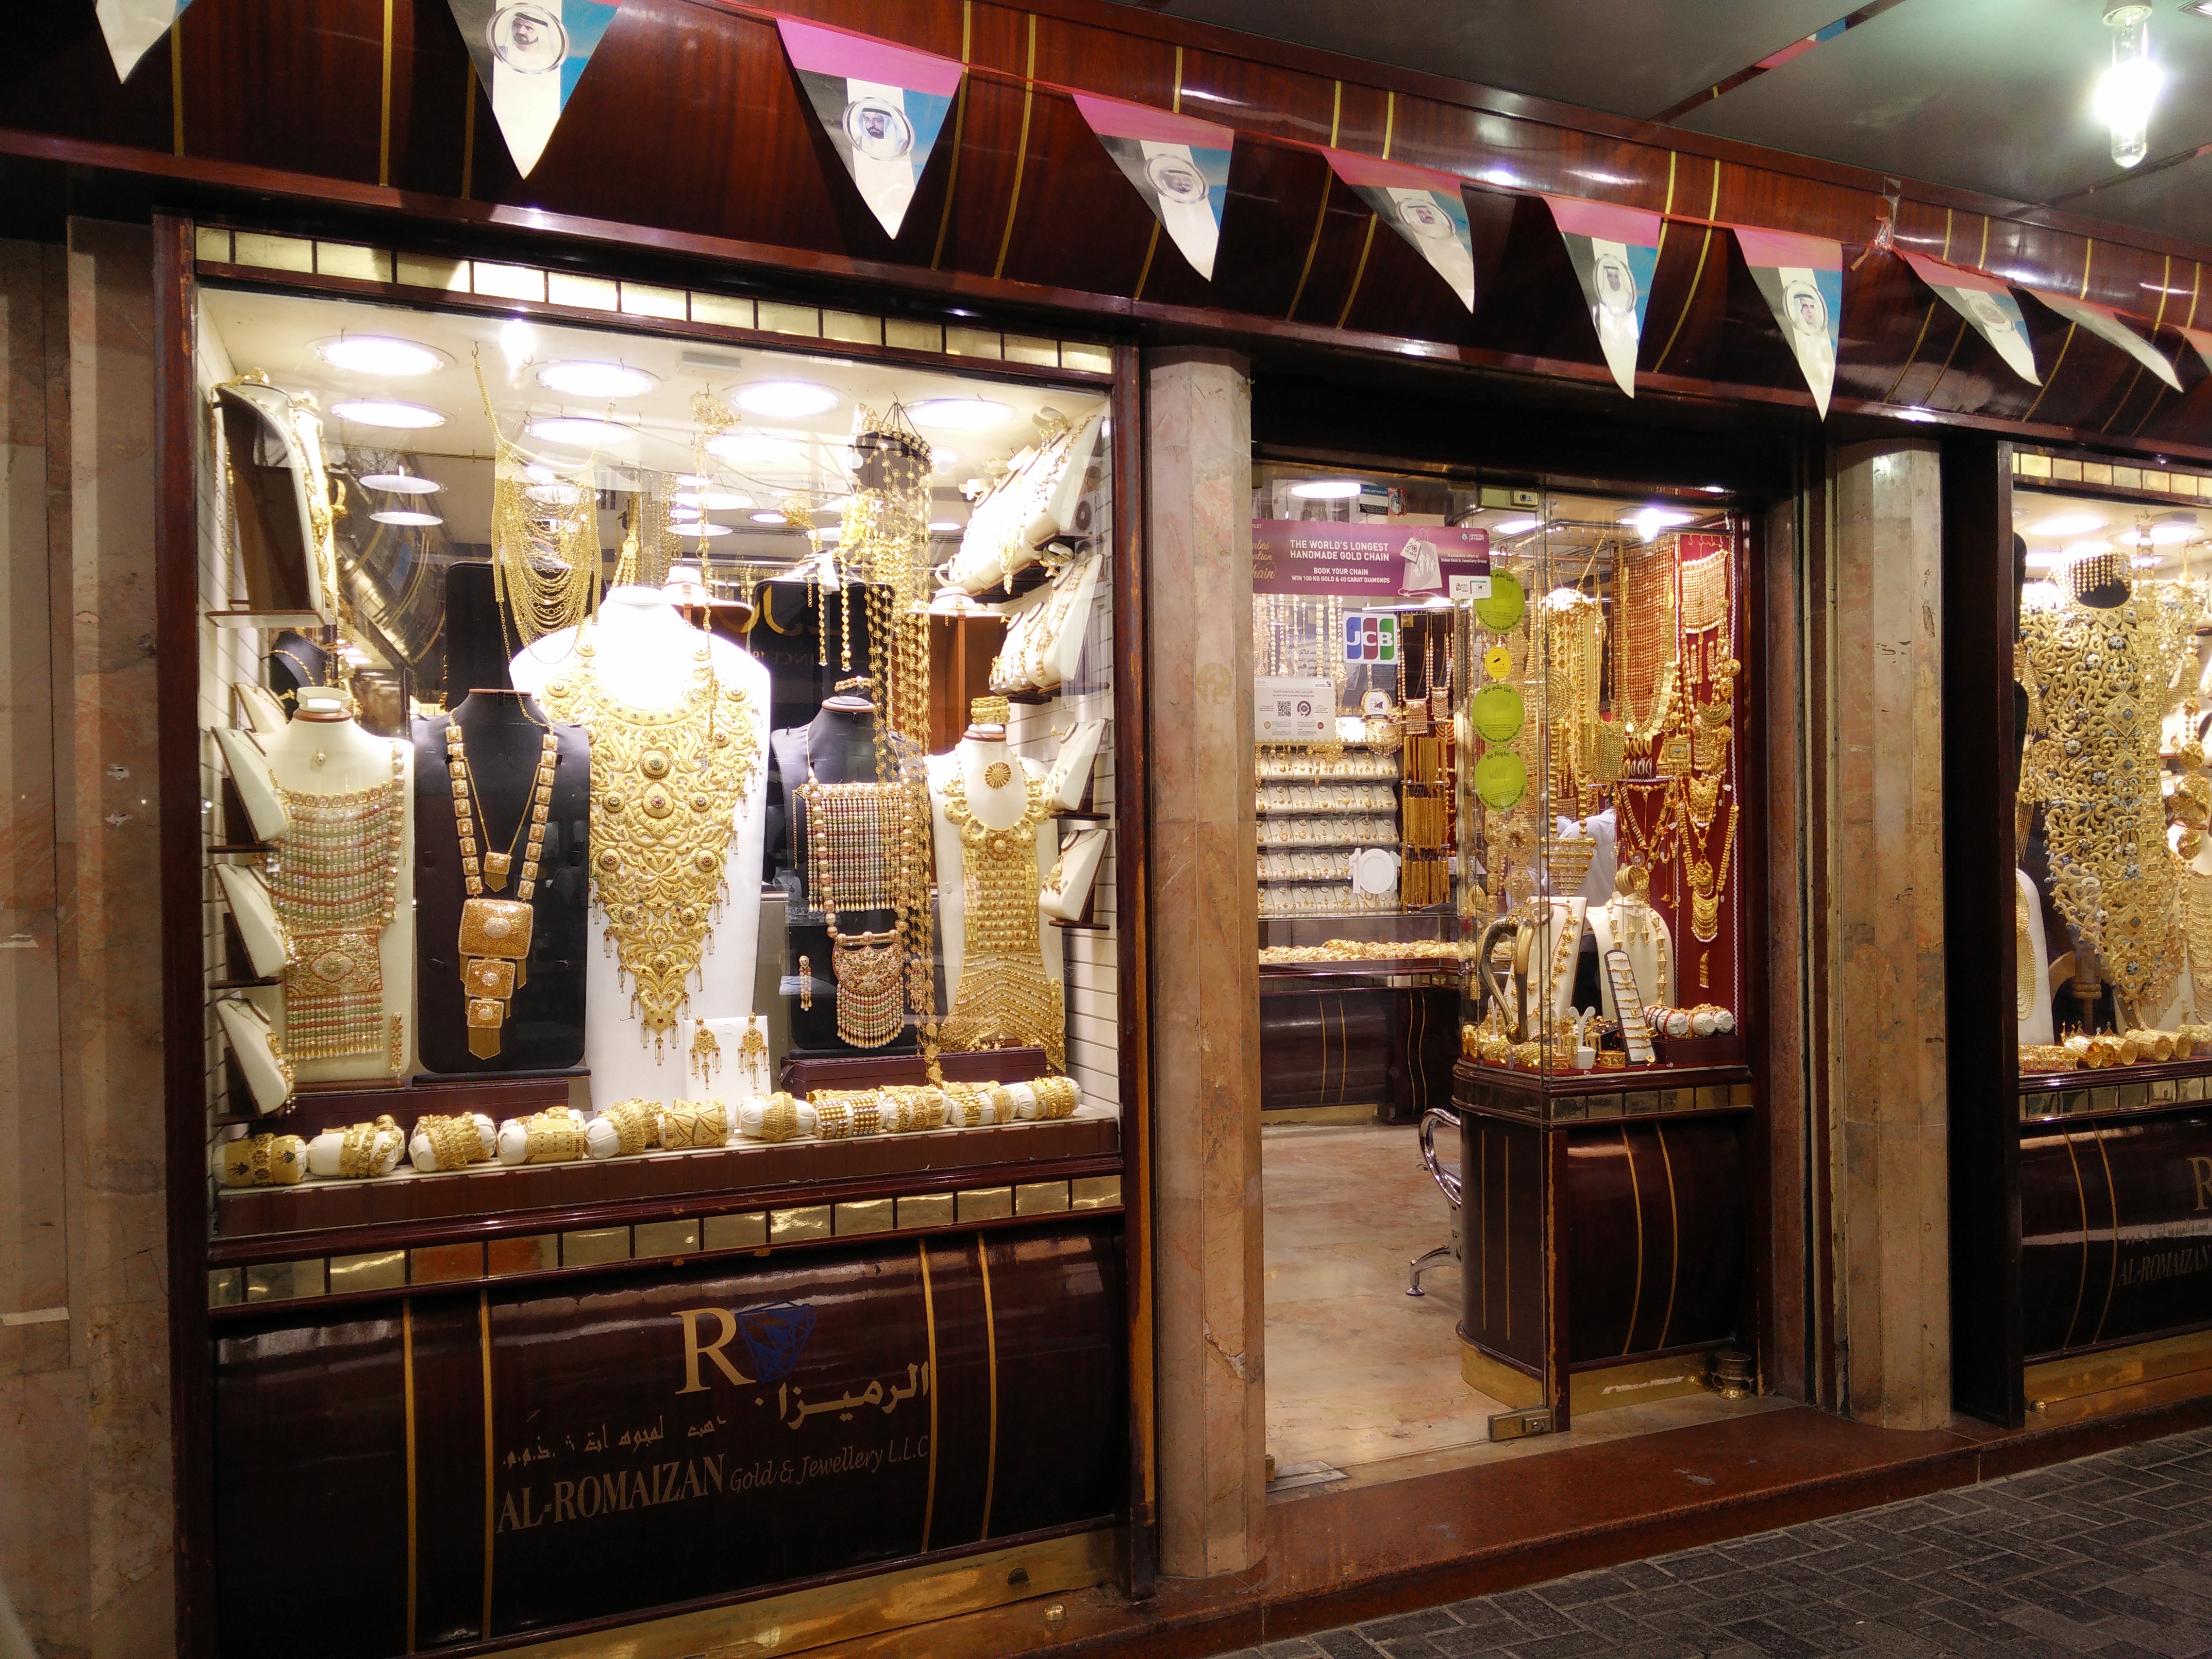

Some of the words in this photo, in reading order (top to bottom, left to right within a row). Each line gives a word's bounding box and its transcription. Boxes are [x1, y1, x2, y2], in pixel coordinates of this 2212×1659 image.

[1289, 540, 1307, 549] THE
[1309, 540, 1348, 550] WORLD'S
[1350, 542, 1388, 551] LONGEST
[1405, 549, 1417, 558] YEARS
[1406, 542, 1418, 553] 20
[1290, 550, 1338, 560] HANDMADE
[1339, 551, 1362, 560] GOLD
[1364, 552, 1389, 562] CHAIN
[1252, 562, 1277, 579] hain
[1346, 631, 1393, 647] JCB
[1480, 793, 1490, 805] Know
[1498, 798, 1518, 810] Consumer
[1517, 785, 1526, 800] Rights
[671, 1307, 756, 1395] R
[496, 1454, 725, 1534] AL-ROMAIZAN
[730, 1460, 778, 1494] Gold
[780, 1460, 794, 1484] &
[796, 1445, 884, 1485] Jewellery
[889, 1435, 928, 1463] L.L.C
